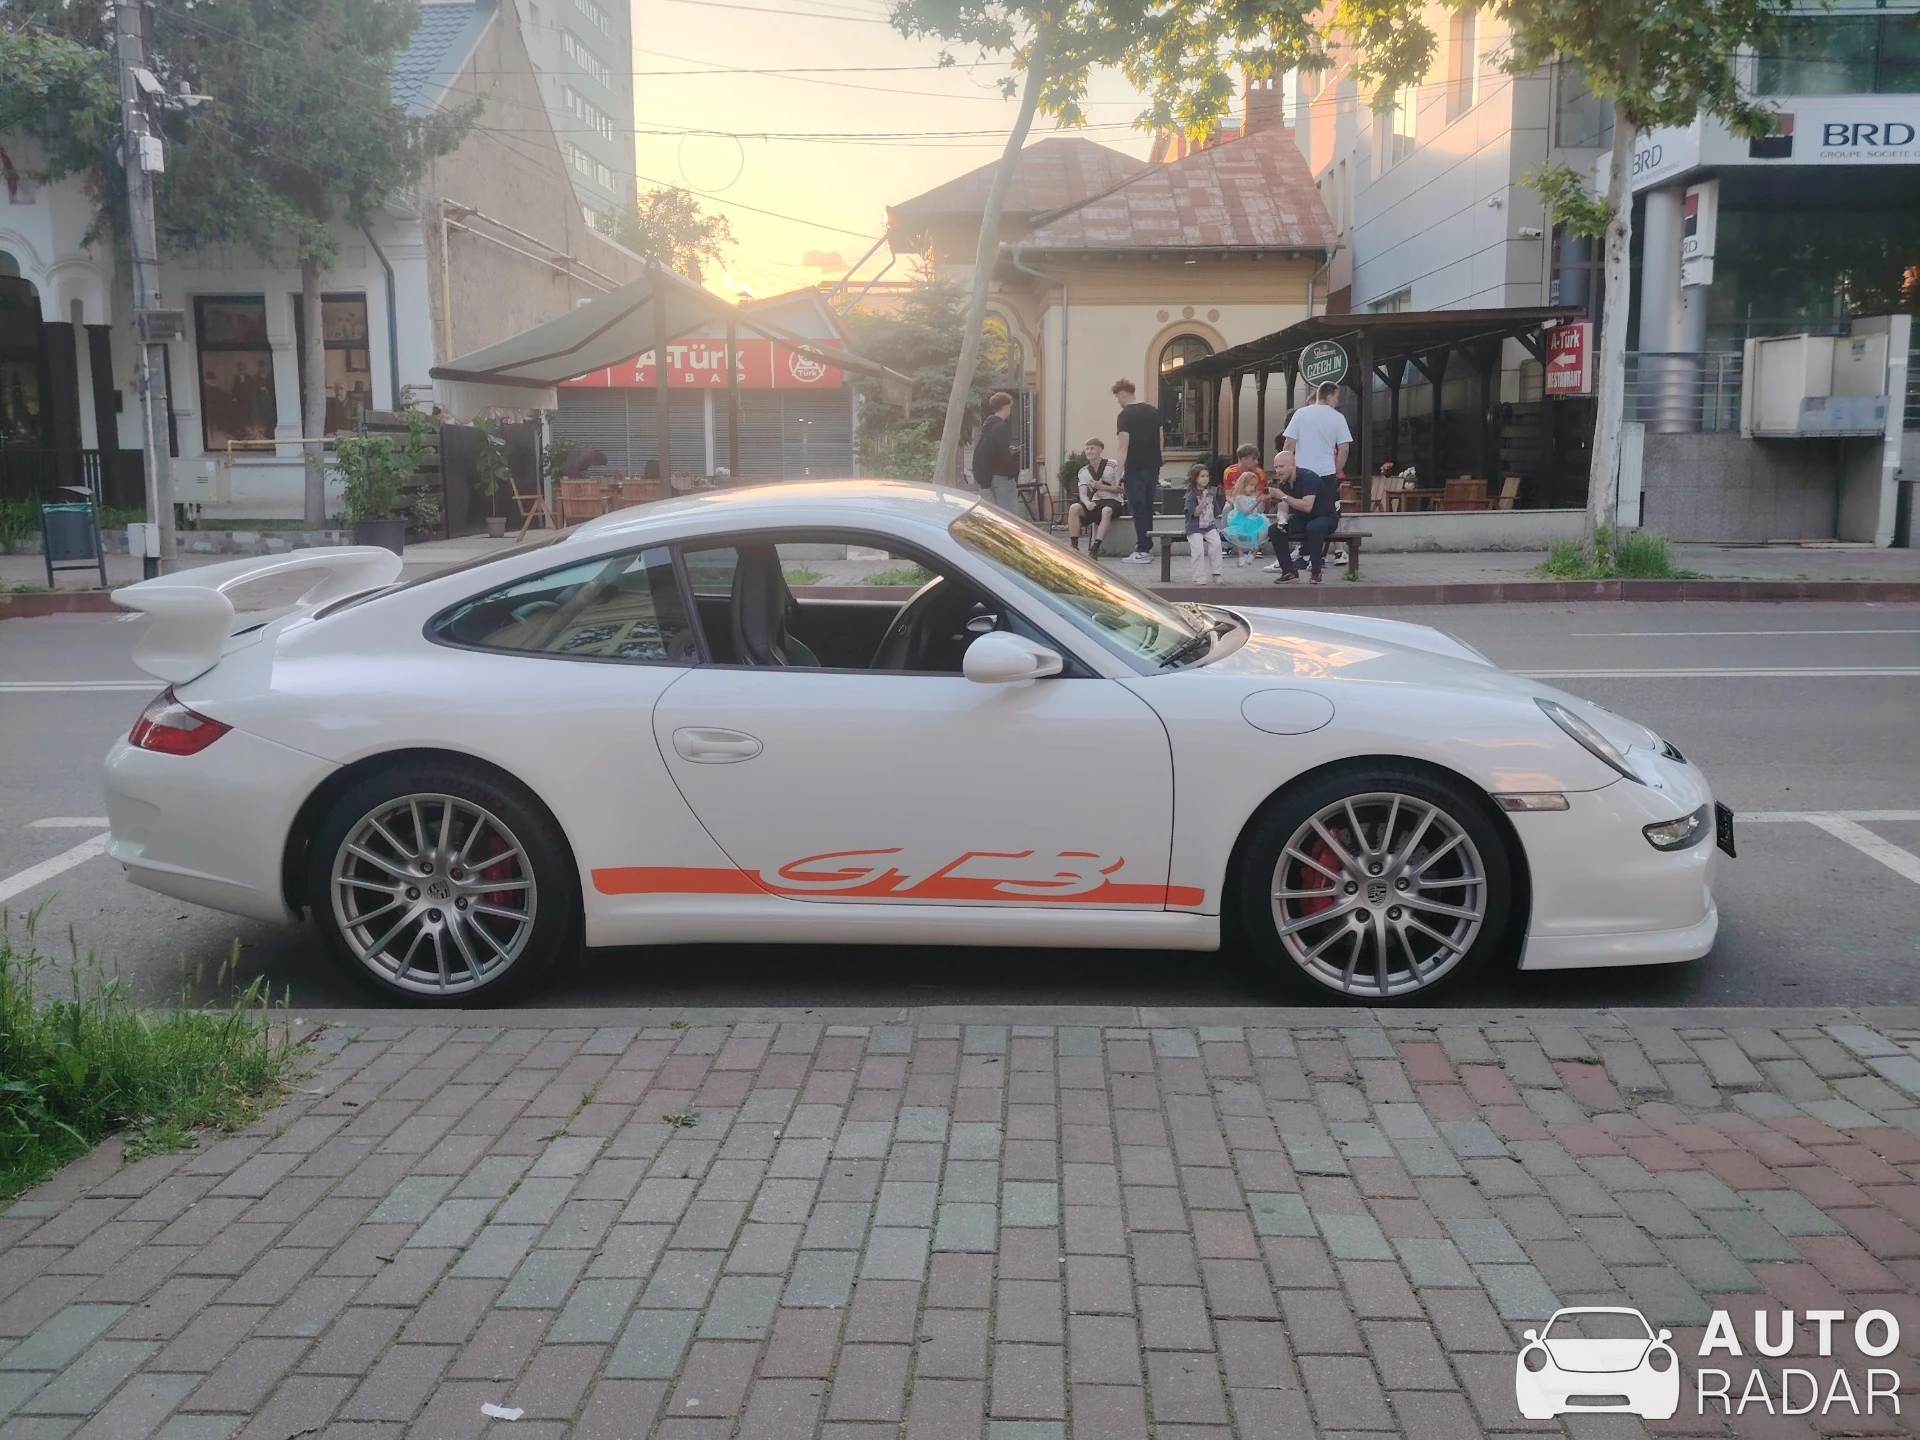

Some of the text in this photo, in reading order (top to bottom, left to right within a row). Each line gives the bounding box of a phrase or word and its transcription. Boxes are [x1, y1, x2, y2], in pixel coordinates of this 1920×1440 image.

[1822, 123, 1916, 147] BRD
[1633, 144, 1663, 176] BRD
[1819, 151, 1861, 159] GROUPE
[1683, 240, 1698, 253] RD
[1550, 329, 1580, 350] A-Türk
[1307, 354, 1342, 378] CZECH IN
[635, 373, 746, 383] KBAP
[758, 847, 1125, 896] GT3
